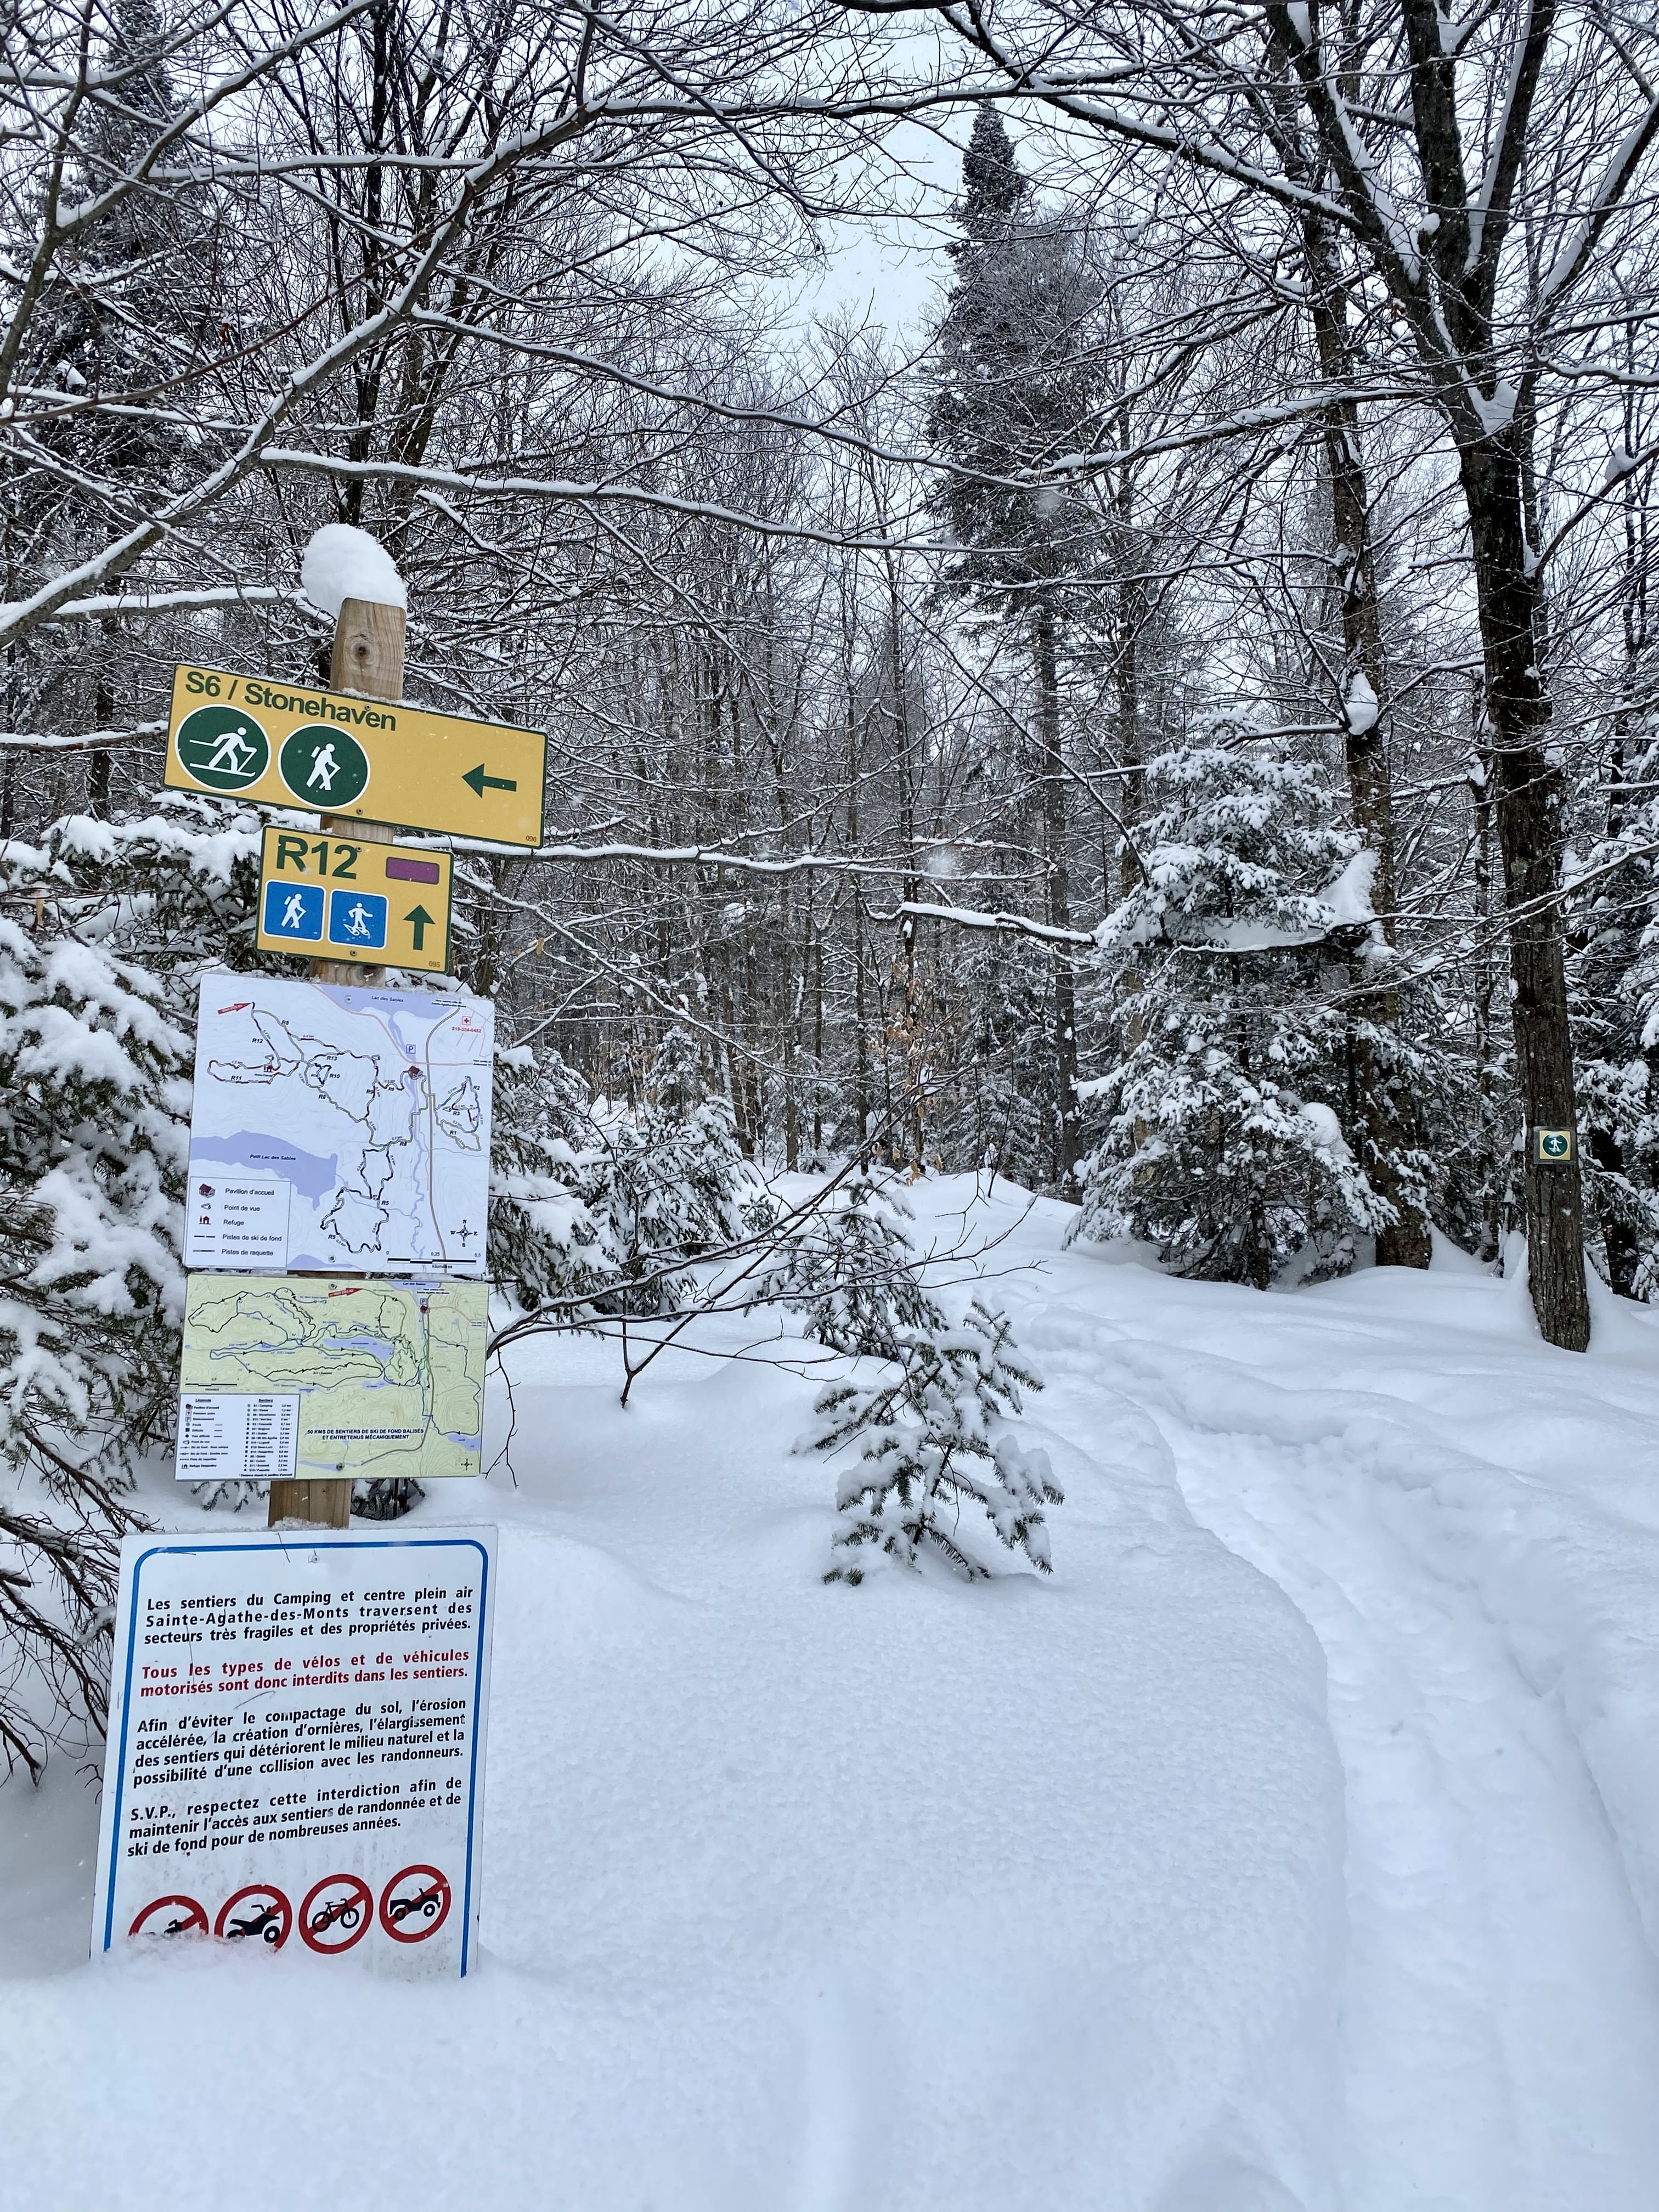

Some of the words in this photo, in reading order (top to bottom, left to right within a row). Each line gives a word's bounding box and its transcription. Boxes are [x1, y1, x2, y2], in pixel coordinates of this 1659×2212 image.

[185, 672, 221, 697] S6
[227, 680, 237, 700] /
[244, 683, 396, 731] Stonehaven
[276, 836, 357, 879] R12
[146, 1607, 348, 1627] Sainte-Agathe-des-Monts
[359, 1604, 438, 1617] traversent
[448, 1602, 471, 1613] des
[148, 1599, 170, 1610] Les
[180, 1595, 236, 1609] sentiers
[247, 1594, 263, 1606] du
[274, 1591, 331, 1606] Camping
[341, 1591, 354, 1601] et
[364, 1590, 405, 1601] centre
[415, 1587, 446, 1602] plein
[456, 1586, 473, 1598] air
[144, 1631, 202, 1645] secteurs
[210, 1628, 236, 1640] très
[244, 1625, 293, 1641] fragiles
[301, 1624, 314, 1635] et
[320, 1622, 342, 1634] des
[349, 1620, 415, 1637] propriétés
[422, 1618, 470, 1633] privées.
[141, 1681, 212, 1697] motorisés
[218, 1679, 249, 1691] sont
[255, 1677, 287, 1689] donc
[293, 1671, 349, 1686] interdits
[354, 1669, 385, 1682] dans
[391, 1668, 408, 1680] les
[413, 1666, 467, 1679] sentiers.
[142, 1667, 177, 1679] Tous
[189, 1662, 210, 1676] les
[222, 1663, 263, 1677] types
[274, 1658, 291, 1671] de
[303, 1655, 340, 1668] vélos
[351, 1655, 365, 1666] et
[376, 1652, 392, 1664] de
[403, 1649, 469, 1663] véhicules
[137, 1719, 167, 1733] Afin
[179, 1714, 233, 1729] d'éviter
[244, 1712, 255, 1724] le
[266, 1707, 345, 1724] compactage
[356, 1703, 371, 1715] du
[381, 1701, 402, 1714] sol,
[412, 1698, 466, 1712] l'érosion
[137, 1733, 207, 1750] accélérée,
[213, 1731, 225, 1743] la
[233, 1726, 288, 1742] création
[295, 1722, 363, 1736] d'ornières,
[370, 1714, 465, 1731] l'élargissement
[136, 1754, 159, 1768] des
[164, 1750, 219, 1765] sentiers
[224, 1746, 245, 1763] qui
[250, 1740, 325, 1757] détériorent
[329, 1738, 340, 1751] le
[345, 1735, 383, 1749] milieu
[388, 1730, 433, 1747] naturel
[437, 1730, 449, 1741] et
[454, 1729, 464, 1741] la
[133, 1767, 207, 1788] possibilité
[215, 1764, 252, 1778] d'une
[259, 1758, 314, 1773] collision
[321, 1757, 351, 1768] avec
[357, 1752, 374, 1764] les
[381, 1748, 462, 1762] randonneurs.
[129, 1819, 200, 1838] maintenir
[204, 1815, 249, 1831] l'accès
[253, 1814, 277, 1825] aux
[281, 1807, 333, 1822] sentiers
[338, 1803, 353, 1816] de
[358, 1797, 425, 1814] randonnée
[430, 1795, 442, 1807] et
[446, 1793, 461, 1805] de
[131, 1805, 176, 1821] S.V.P.,
[188, 1798, 259, 1816] respectez
[270, 1793, 306, 1806] cette
[317, 1783, 399, 1802] interdiction
[410, 1779, 436, 1792] afin
[446, 1777, 461, 1789] de
[128, 1842, 148, 1857] ski
[153, 1840, 170, 1854] de
[174, 1835, 207, 1851] fond
[211, 1835, 244, 1850] pour
[248, 1830, 264, 1843] de
[269, 1823, 348, 1841] nombreuses
[353, 1816, 400, 1831] années.
